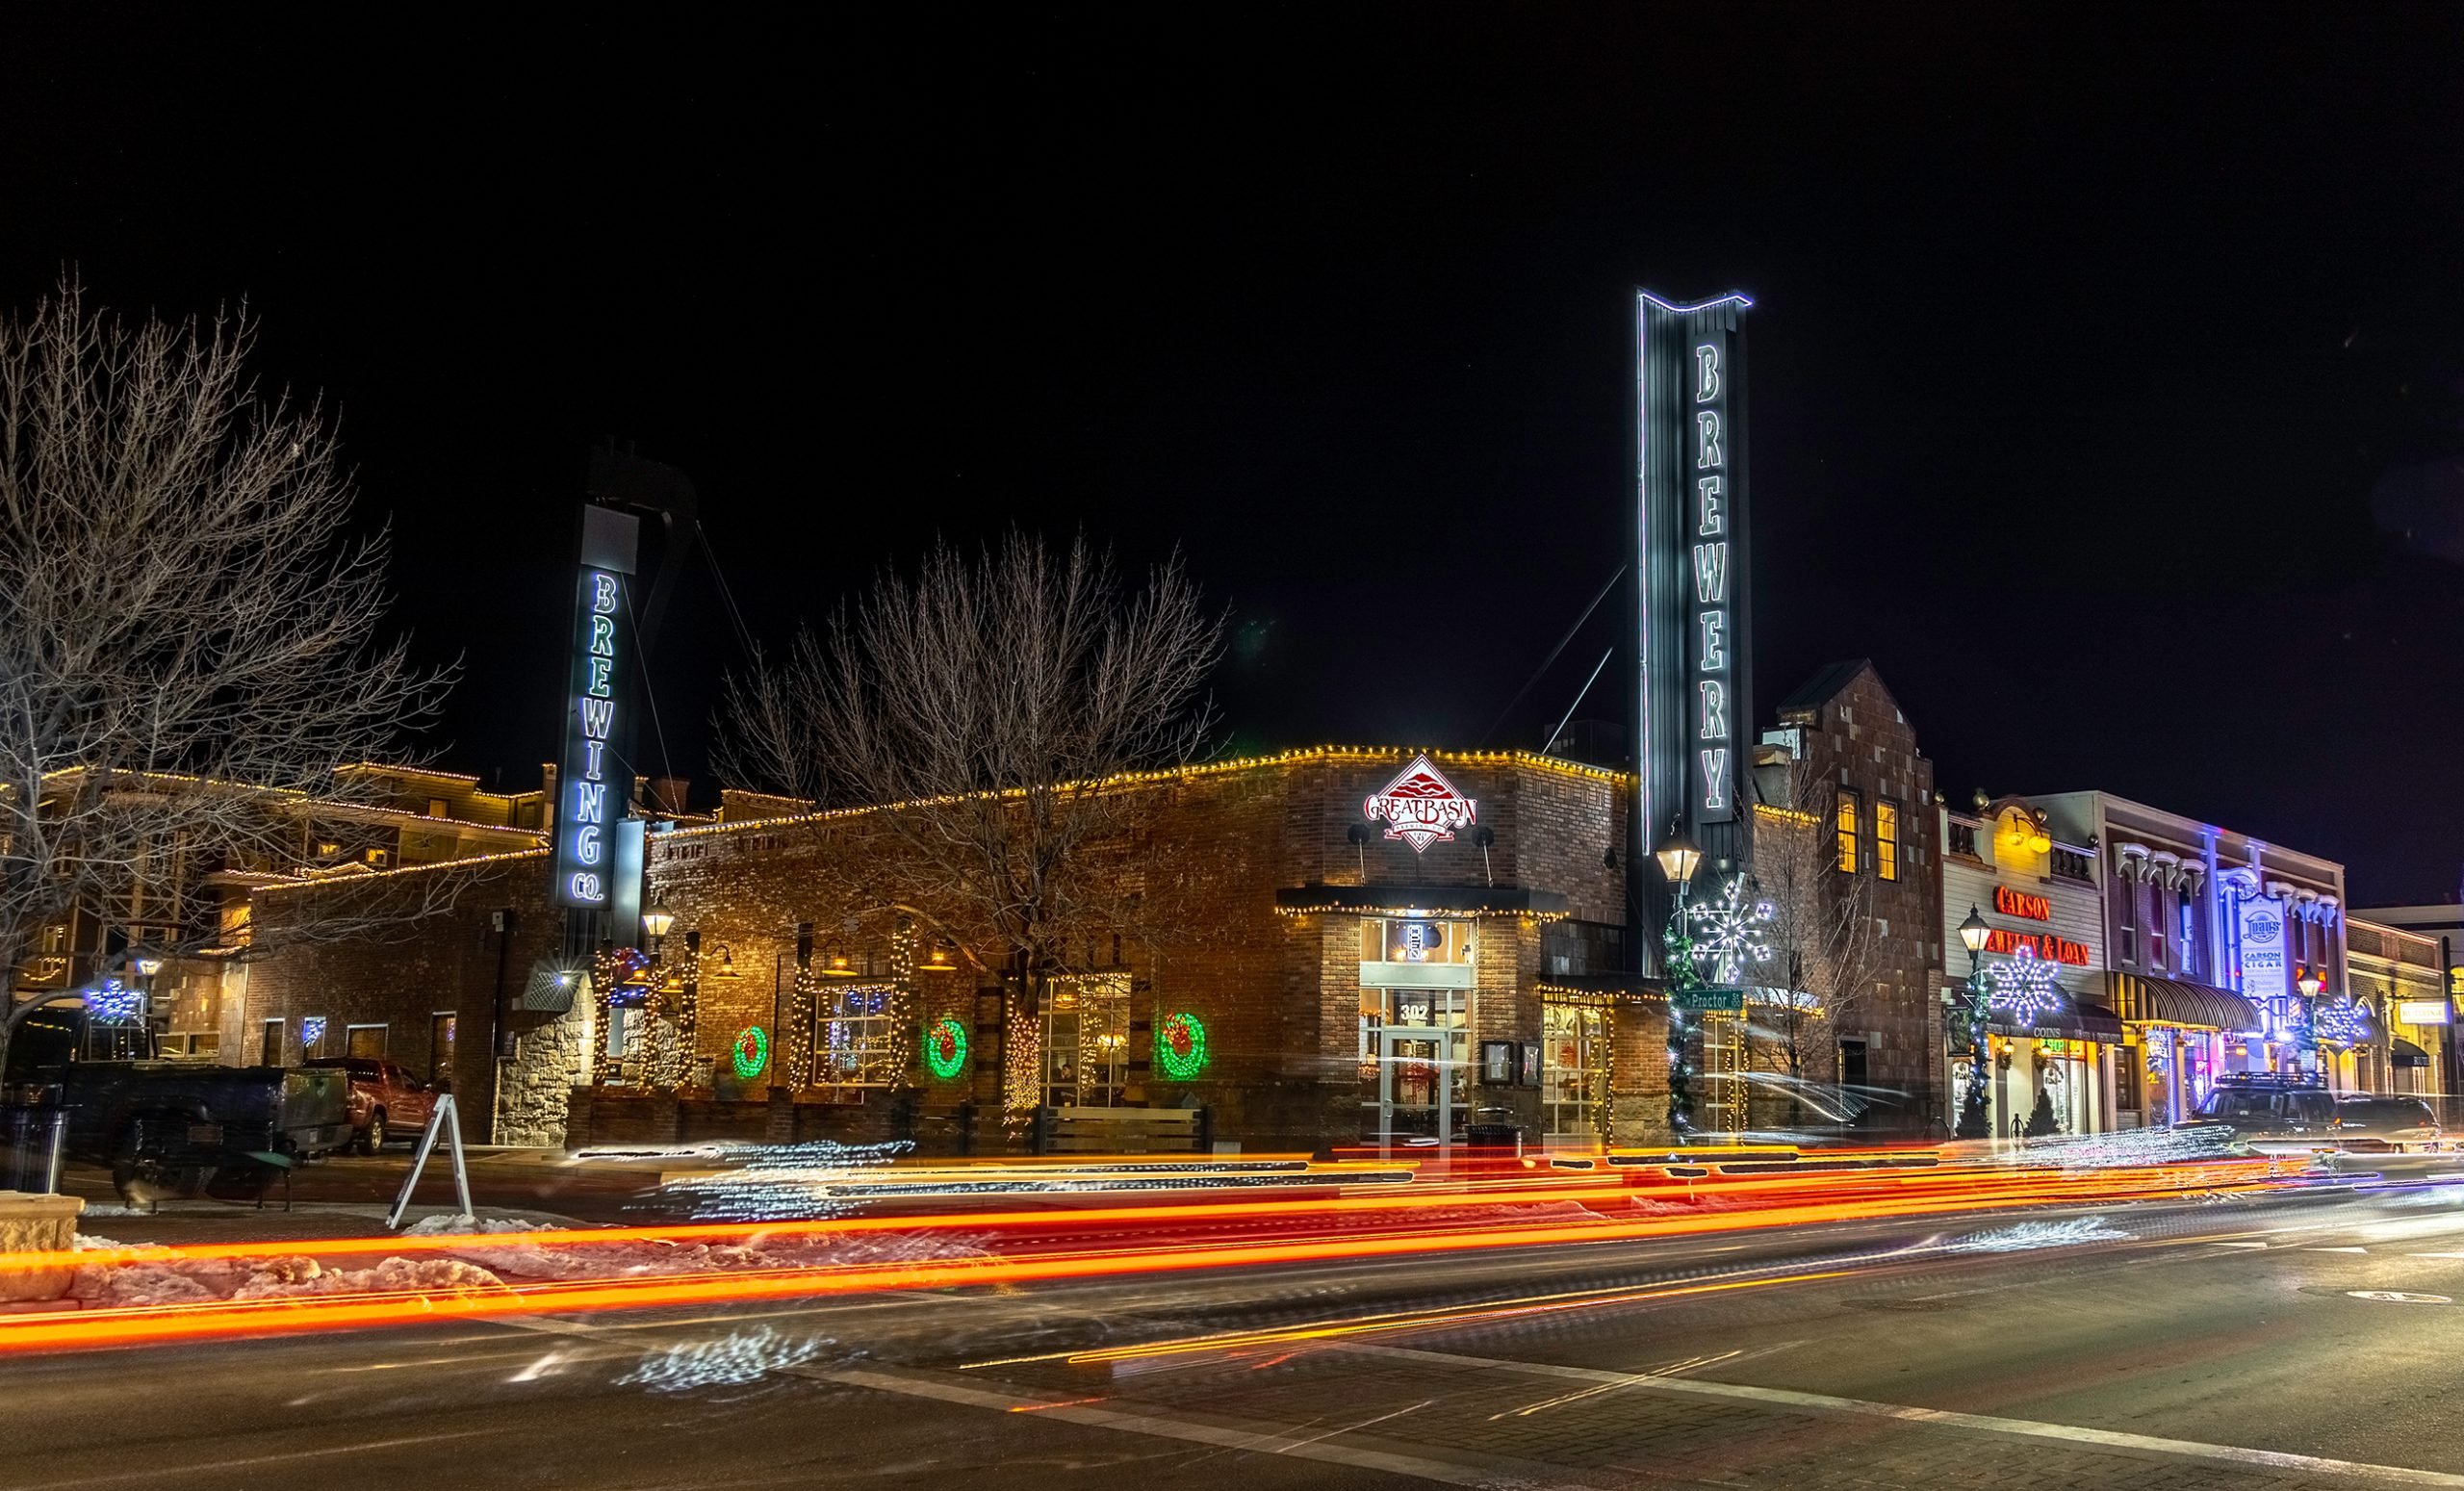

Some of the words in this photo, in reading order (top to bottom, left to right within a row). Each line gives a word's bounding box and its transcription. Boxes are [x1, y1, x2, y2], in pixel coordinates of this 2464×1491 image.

[1694, 345, 1727, 809] BREWERY
[578, 574, 617, 865] BREWING
[1365, 795, 1423, 821] GREAT
[1416, 798, 1476, 828] BASIN
[1995, 885, 2050, 921] CARSON
[1986, 929, 2039, 959] EWELRY
[2041, 934, 2054, 961] &
[2056, 936, 2089, 966] LOAN
[1400, 1004, 1428, 1020] 302
[1692, 993, 1727, 1008] Proctor
[2034, 1026, 2061, 1038] COINS
